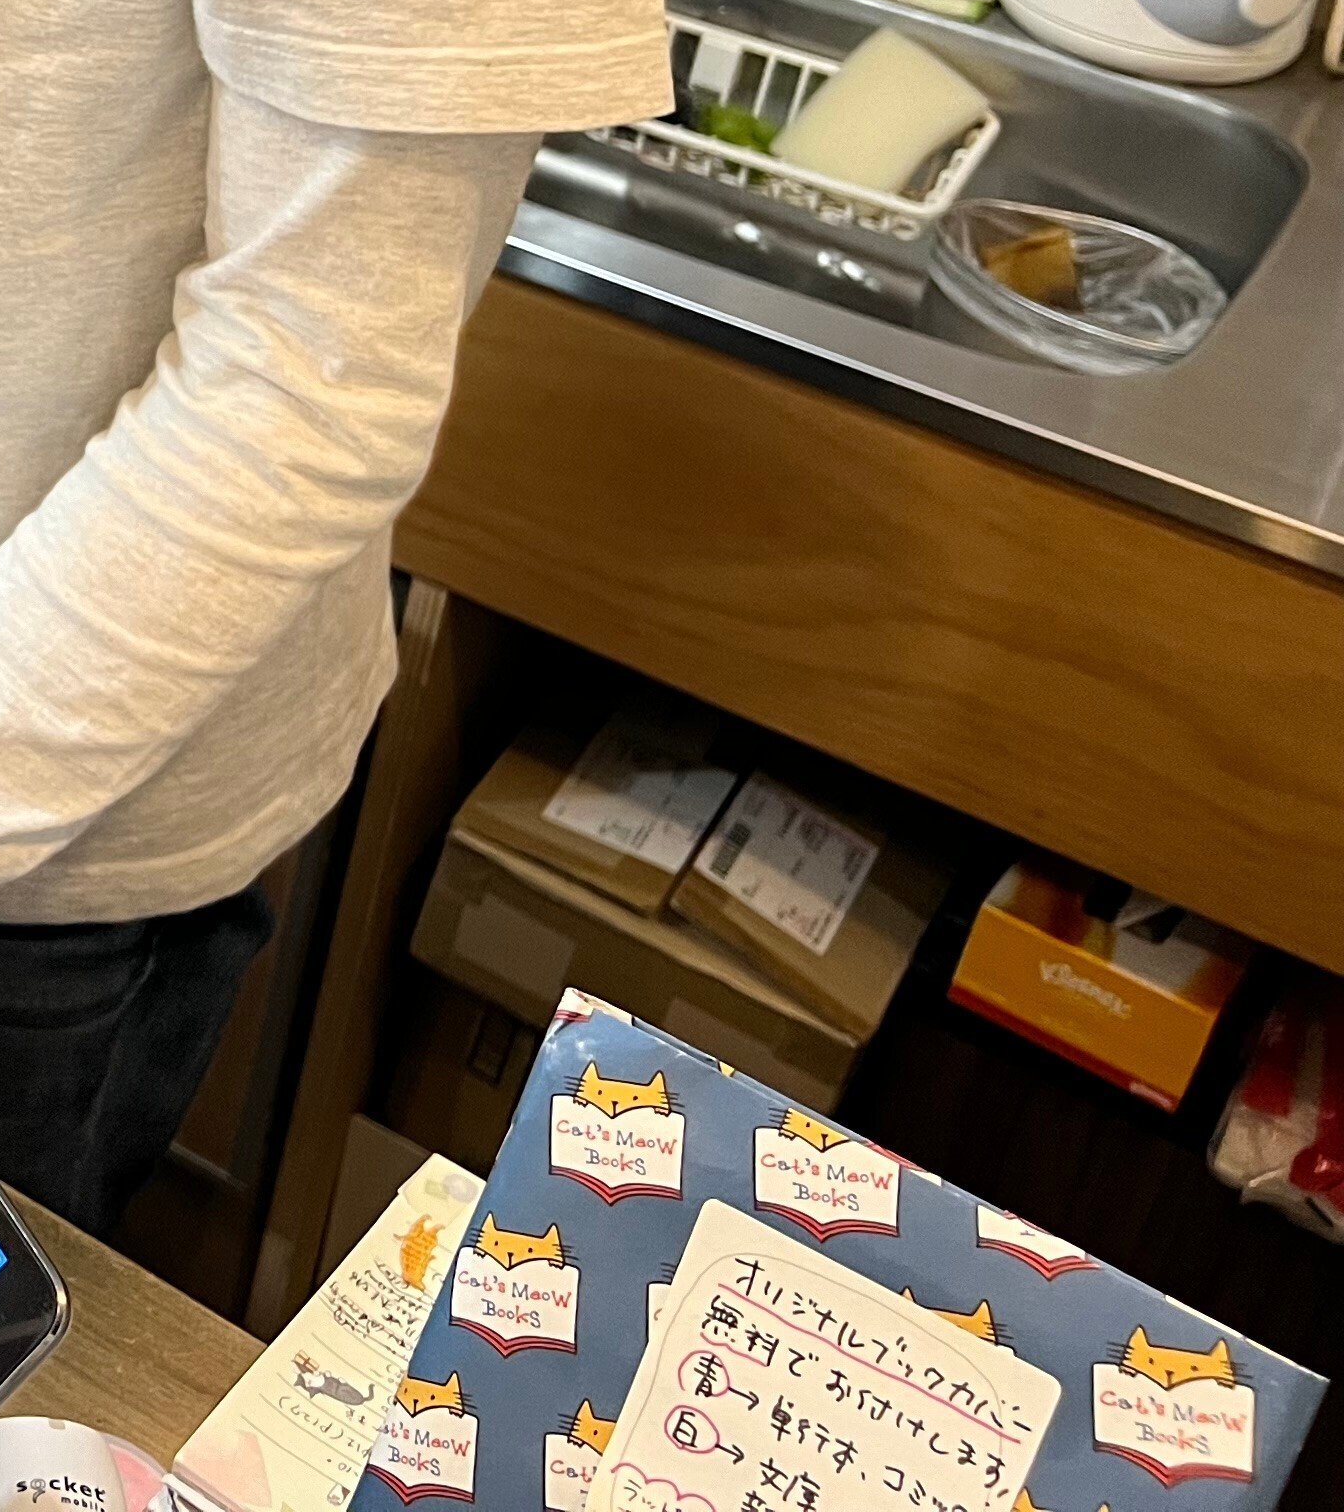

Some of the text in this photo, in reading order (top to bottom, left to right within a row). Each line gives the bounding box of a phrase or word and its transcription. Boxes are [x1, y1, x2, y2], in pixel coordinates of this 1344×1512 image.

[557, 1119, 610, 1143] Cat's
[760, 1152, 820, 1177] Cat's
[457, 1269, 507, 1303] Cat's
[735, 1257, 1032, 1433] オリジナルブックカバー
[1099, 1390, 1165, 1416] Cat's
[671, 1411, 698, 1448] 白
[693, 1353, 720, 1397] 青
[770, 1395, 973, 1512] 単行本、コミッ
[550, 1459, 598, 1484] Cat'
[16, 1475, 108, 1504] socket
